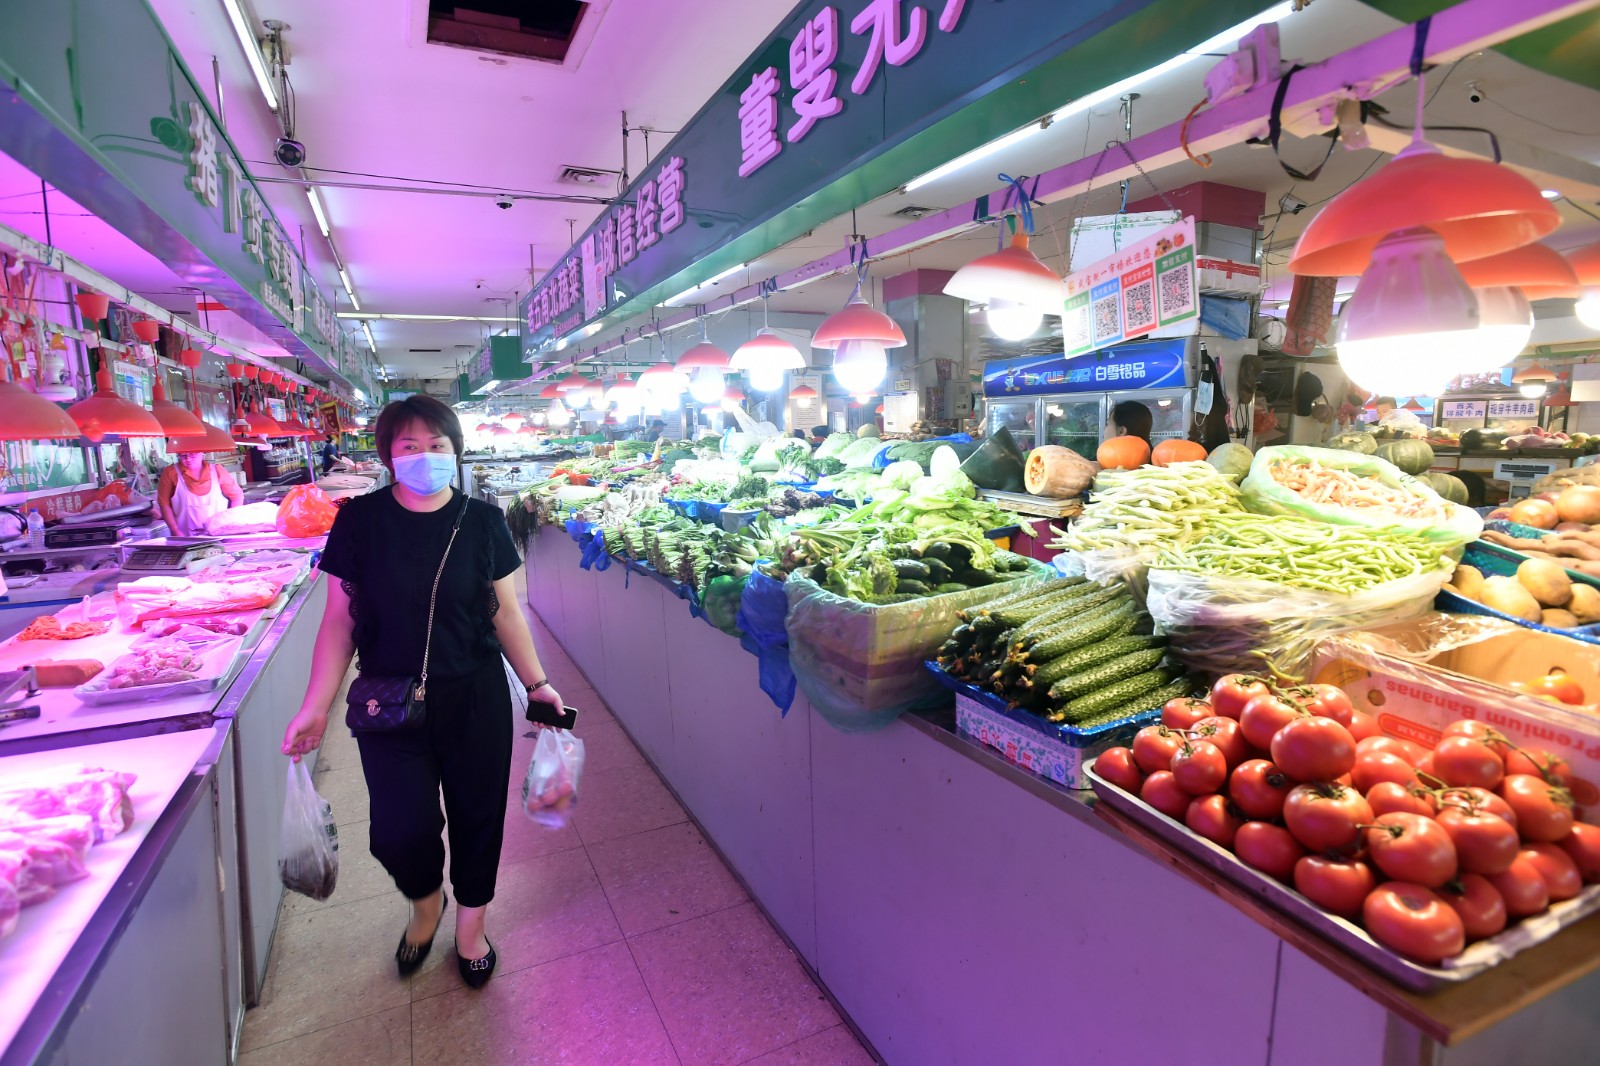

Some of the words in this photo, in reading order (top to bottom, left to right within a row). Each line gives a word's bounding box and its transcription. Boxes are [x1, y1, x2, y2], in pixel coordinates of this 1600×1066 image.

[598, 156, 685, 277] 诚信经营
[1095, 361, 1146, 381] 白雪铭品
[1490, 403, 1535, 415] 现穿牛羊肉串
[1385, 680, 1478, 721] Bananas
